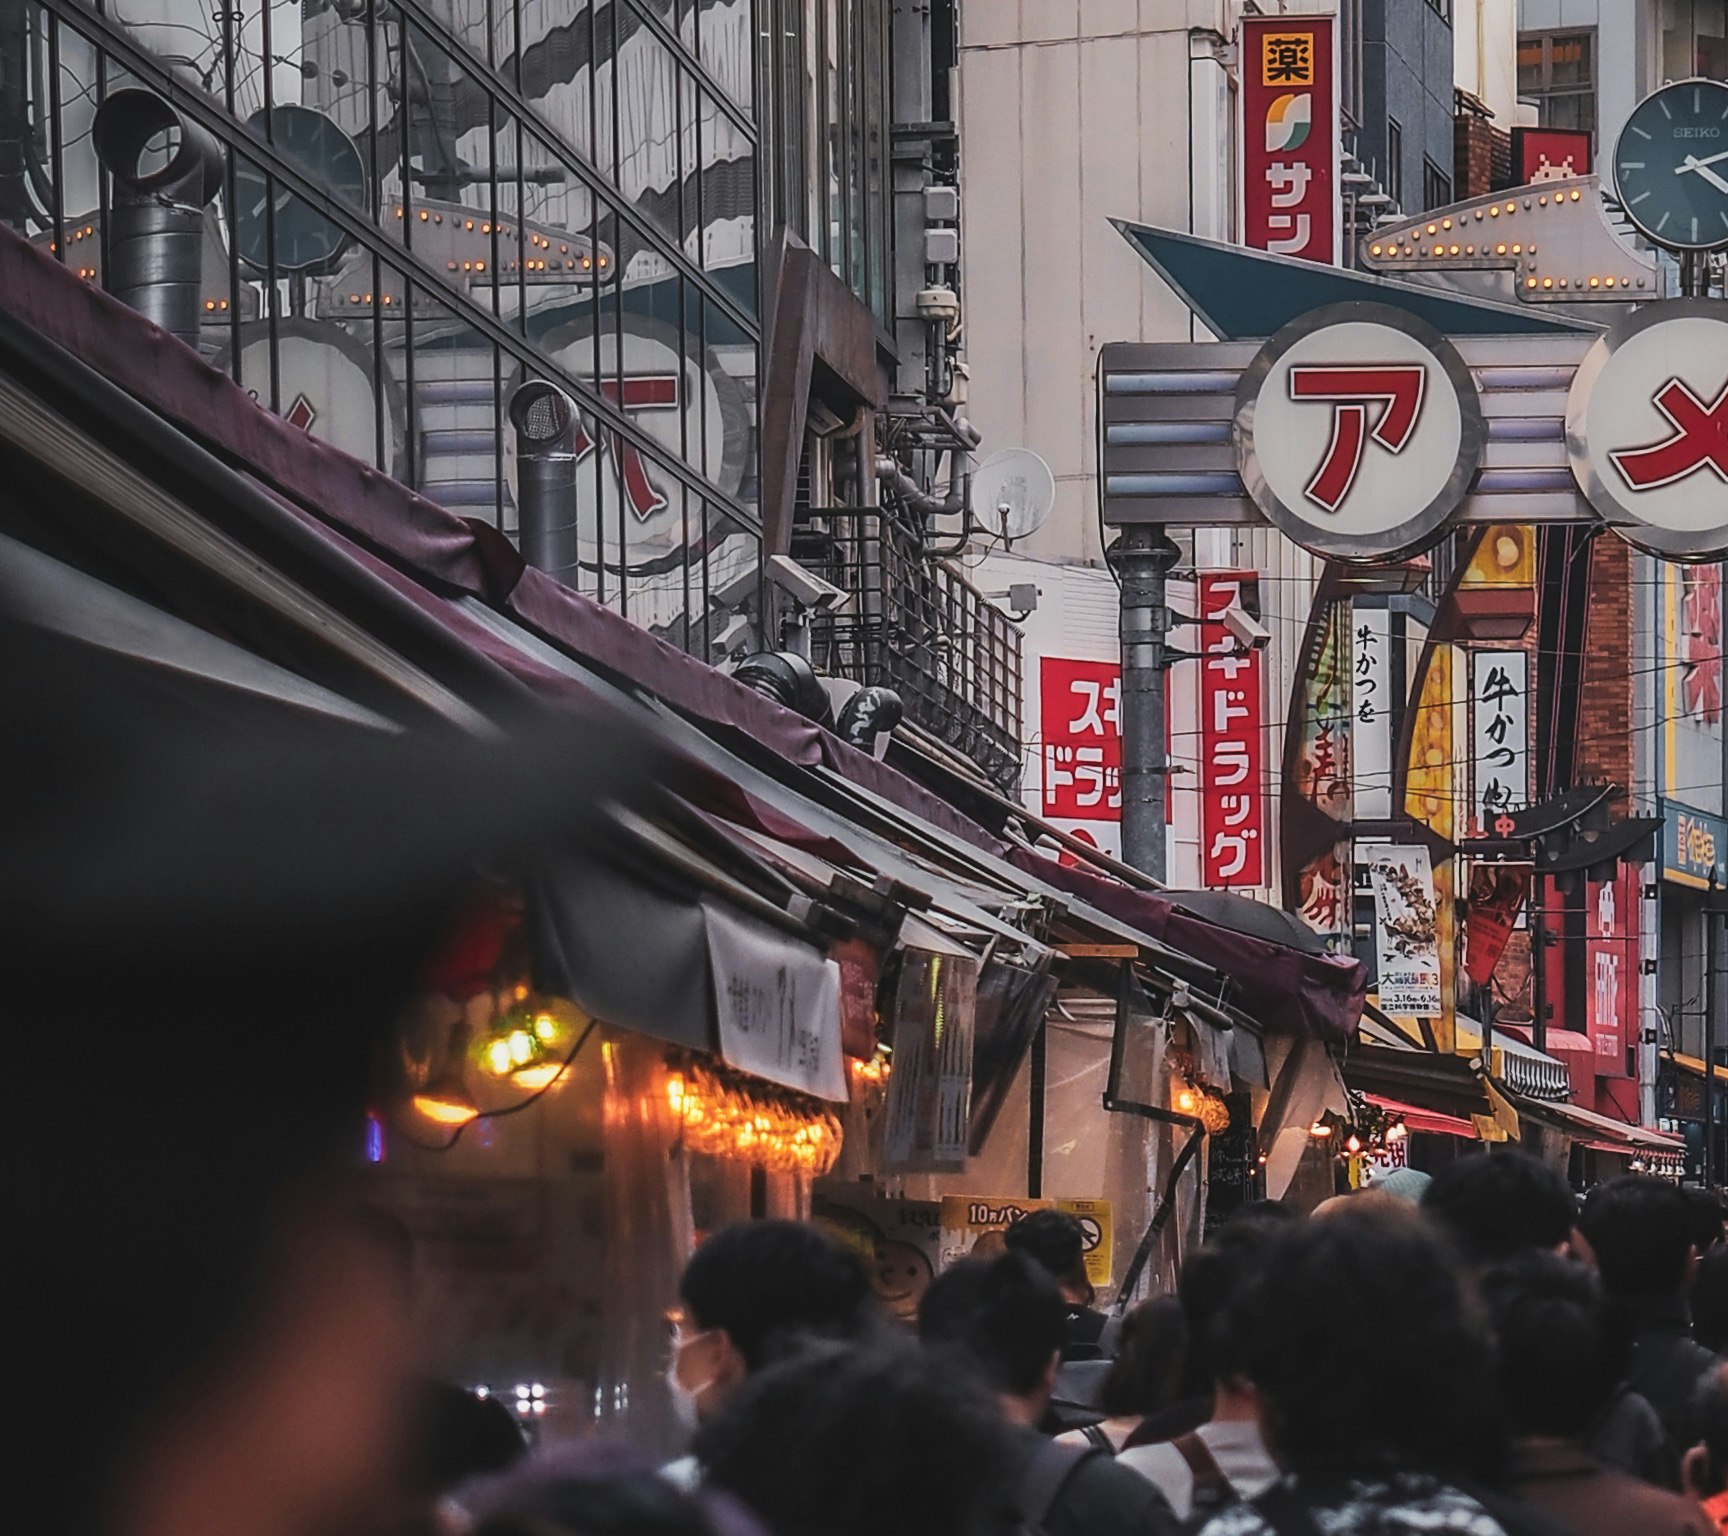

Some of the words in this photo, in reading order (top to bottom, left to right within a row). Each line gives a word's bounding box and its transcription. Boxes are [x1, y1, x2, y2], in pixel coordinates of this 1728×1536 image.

[1266, 38, 1310, 81] 薬
[1673, 127, 1720, 138] SEIKO
[1267, 161, 1311, 254] サン
[1045, 744, 1123, 809] ドラッ
